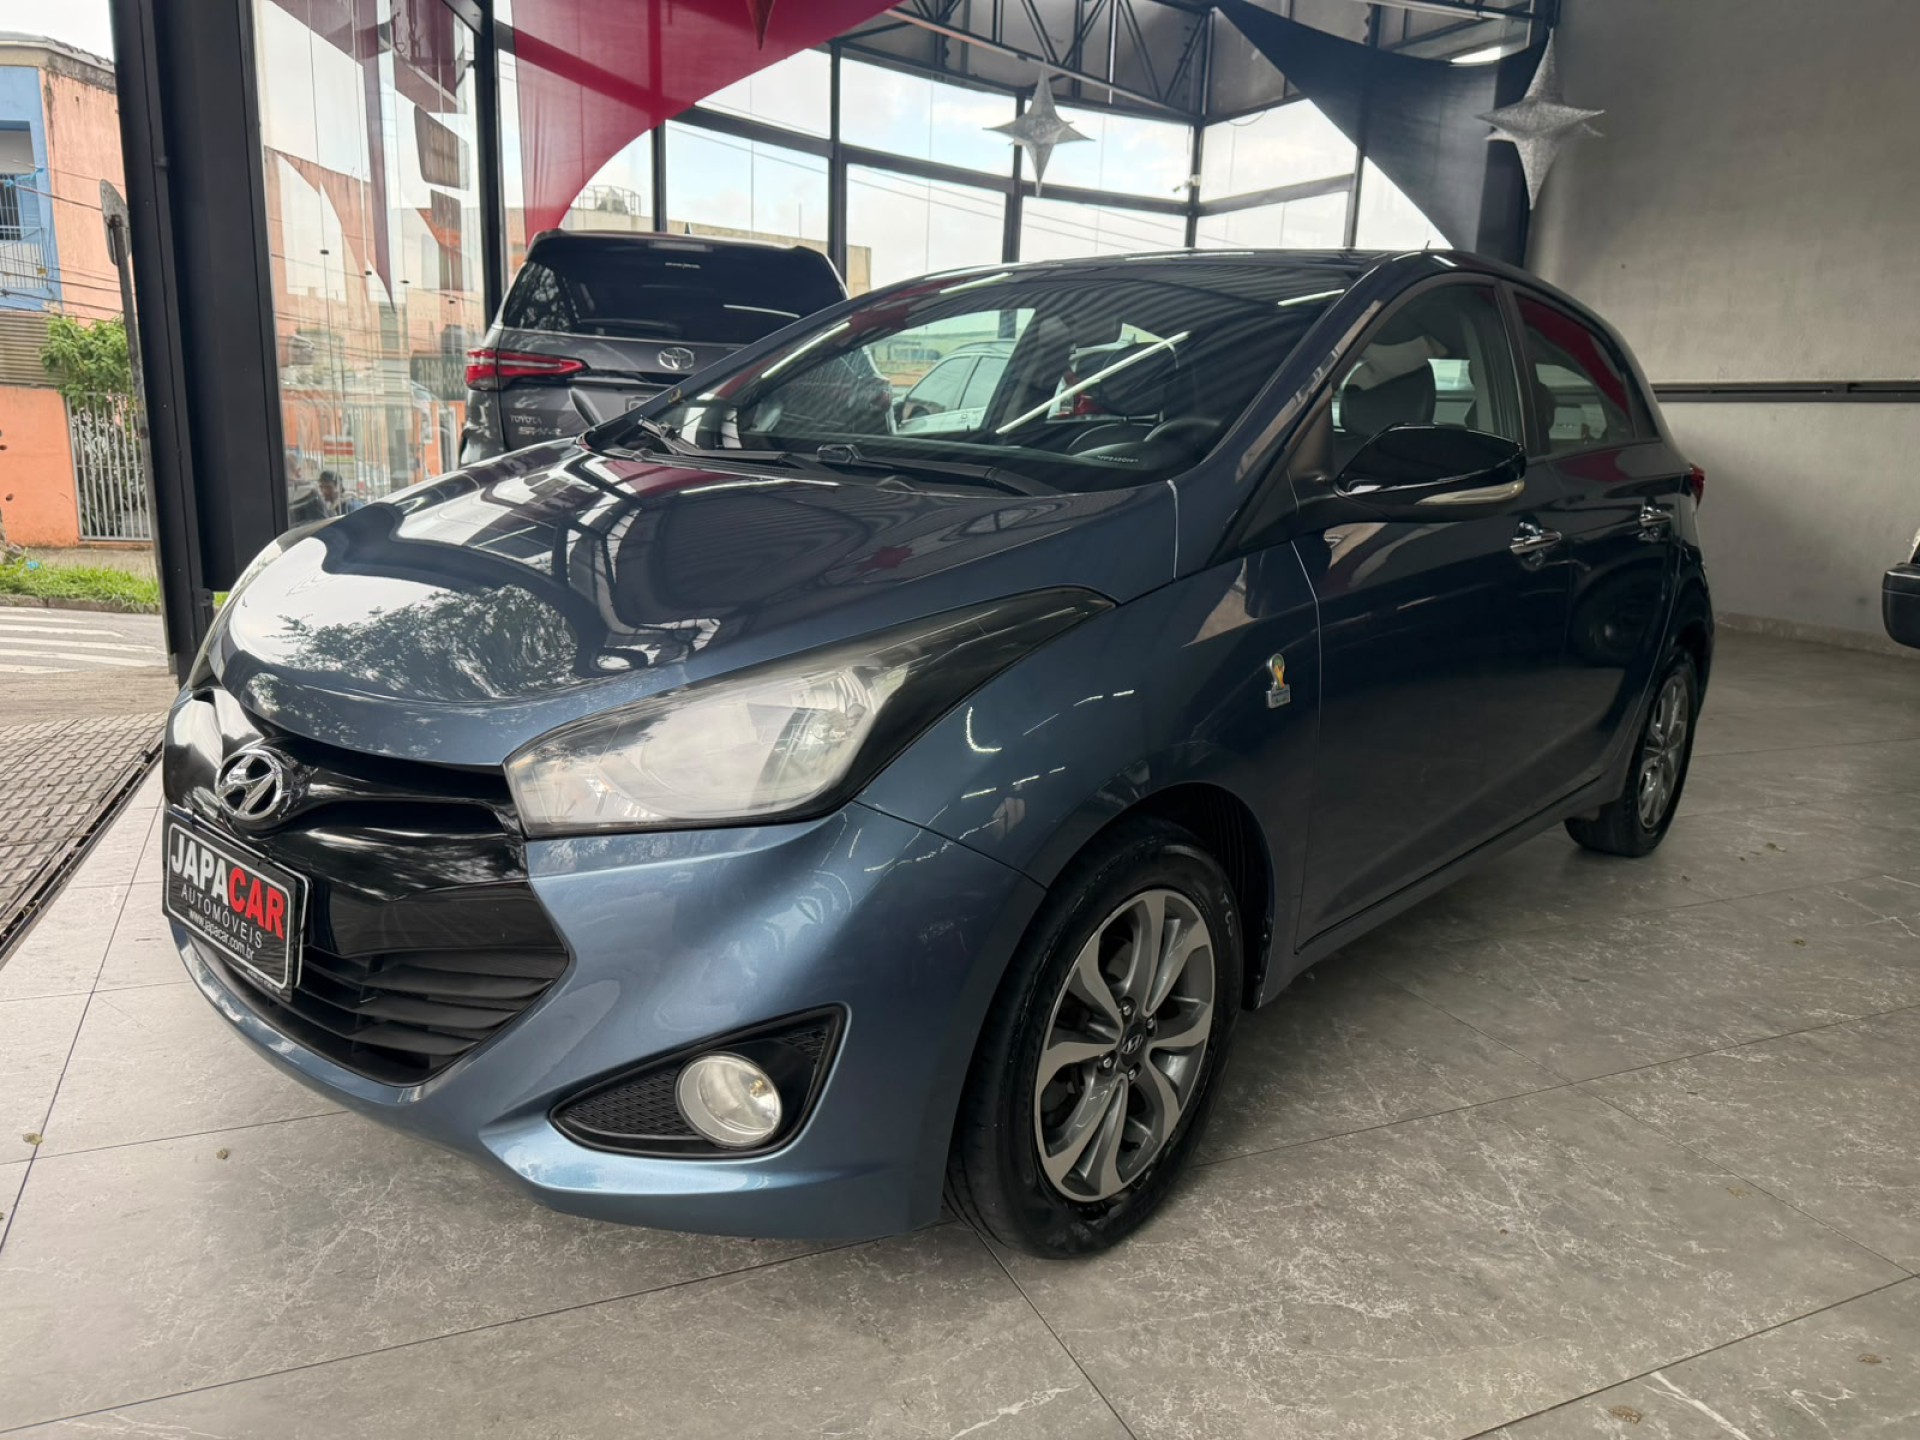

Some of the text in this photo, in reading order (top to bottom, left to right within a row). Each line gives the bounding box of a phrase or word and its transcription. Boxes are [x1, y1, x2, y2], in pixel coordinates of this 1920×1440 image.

[171, 833, 285, 940] JAPACAR
[181, 883, 263, 949] AUTOMÓVEIS
[188, 909, 255, 961] www.japacar.com.br
